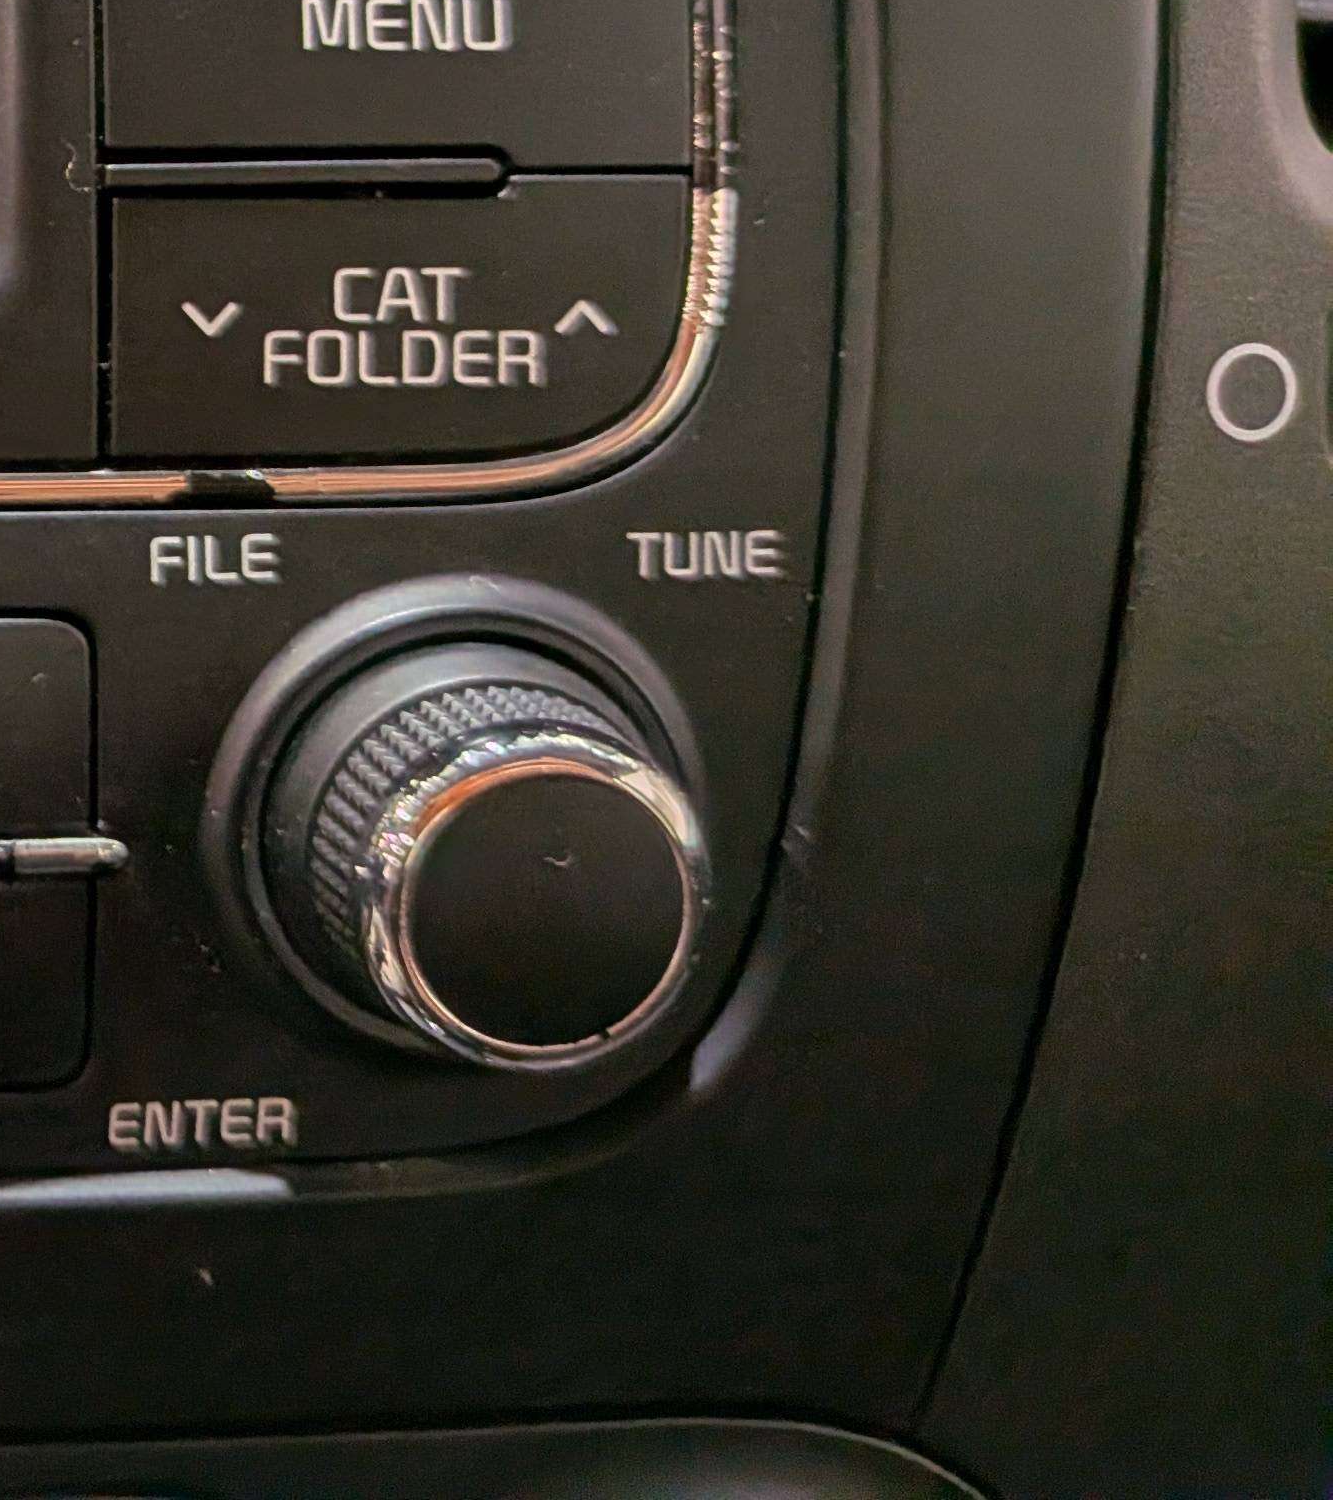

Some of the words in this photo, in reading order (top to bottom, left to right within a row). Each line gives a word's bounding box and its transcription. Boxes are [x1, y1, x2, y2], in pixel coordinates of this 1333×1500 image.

[332, 267, 470, 323] CAT
[262, 329, 548, 387] FOLDER
[149, 532, 282, 585] FILE
[626, 529, 785, 581] TUNE
[108, 1096, 298, 1151] ENTER
